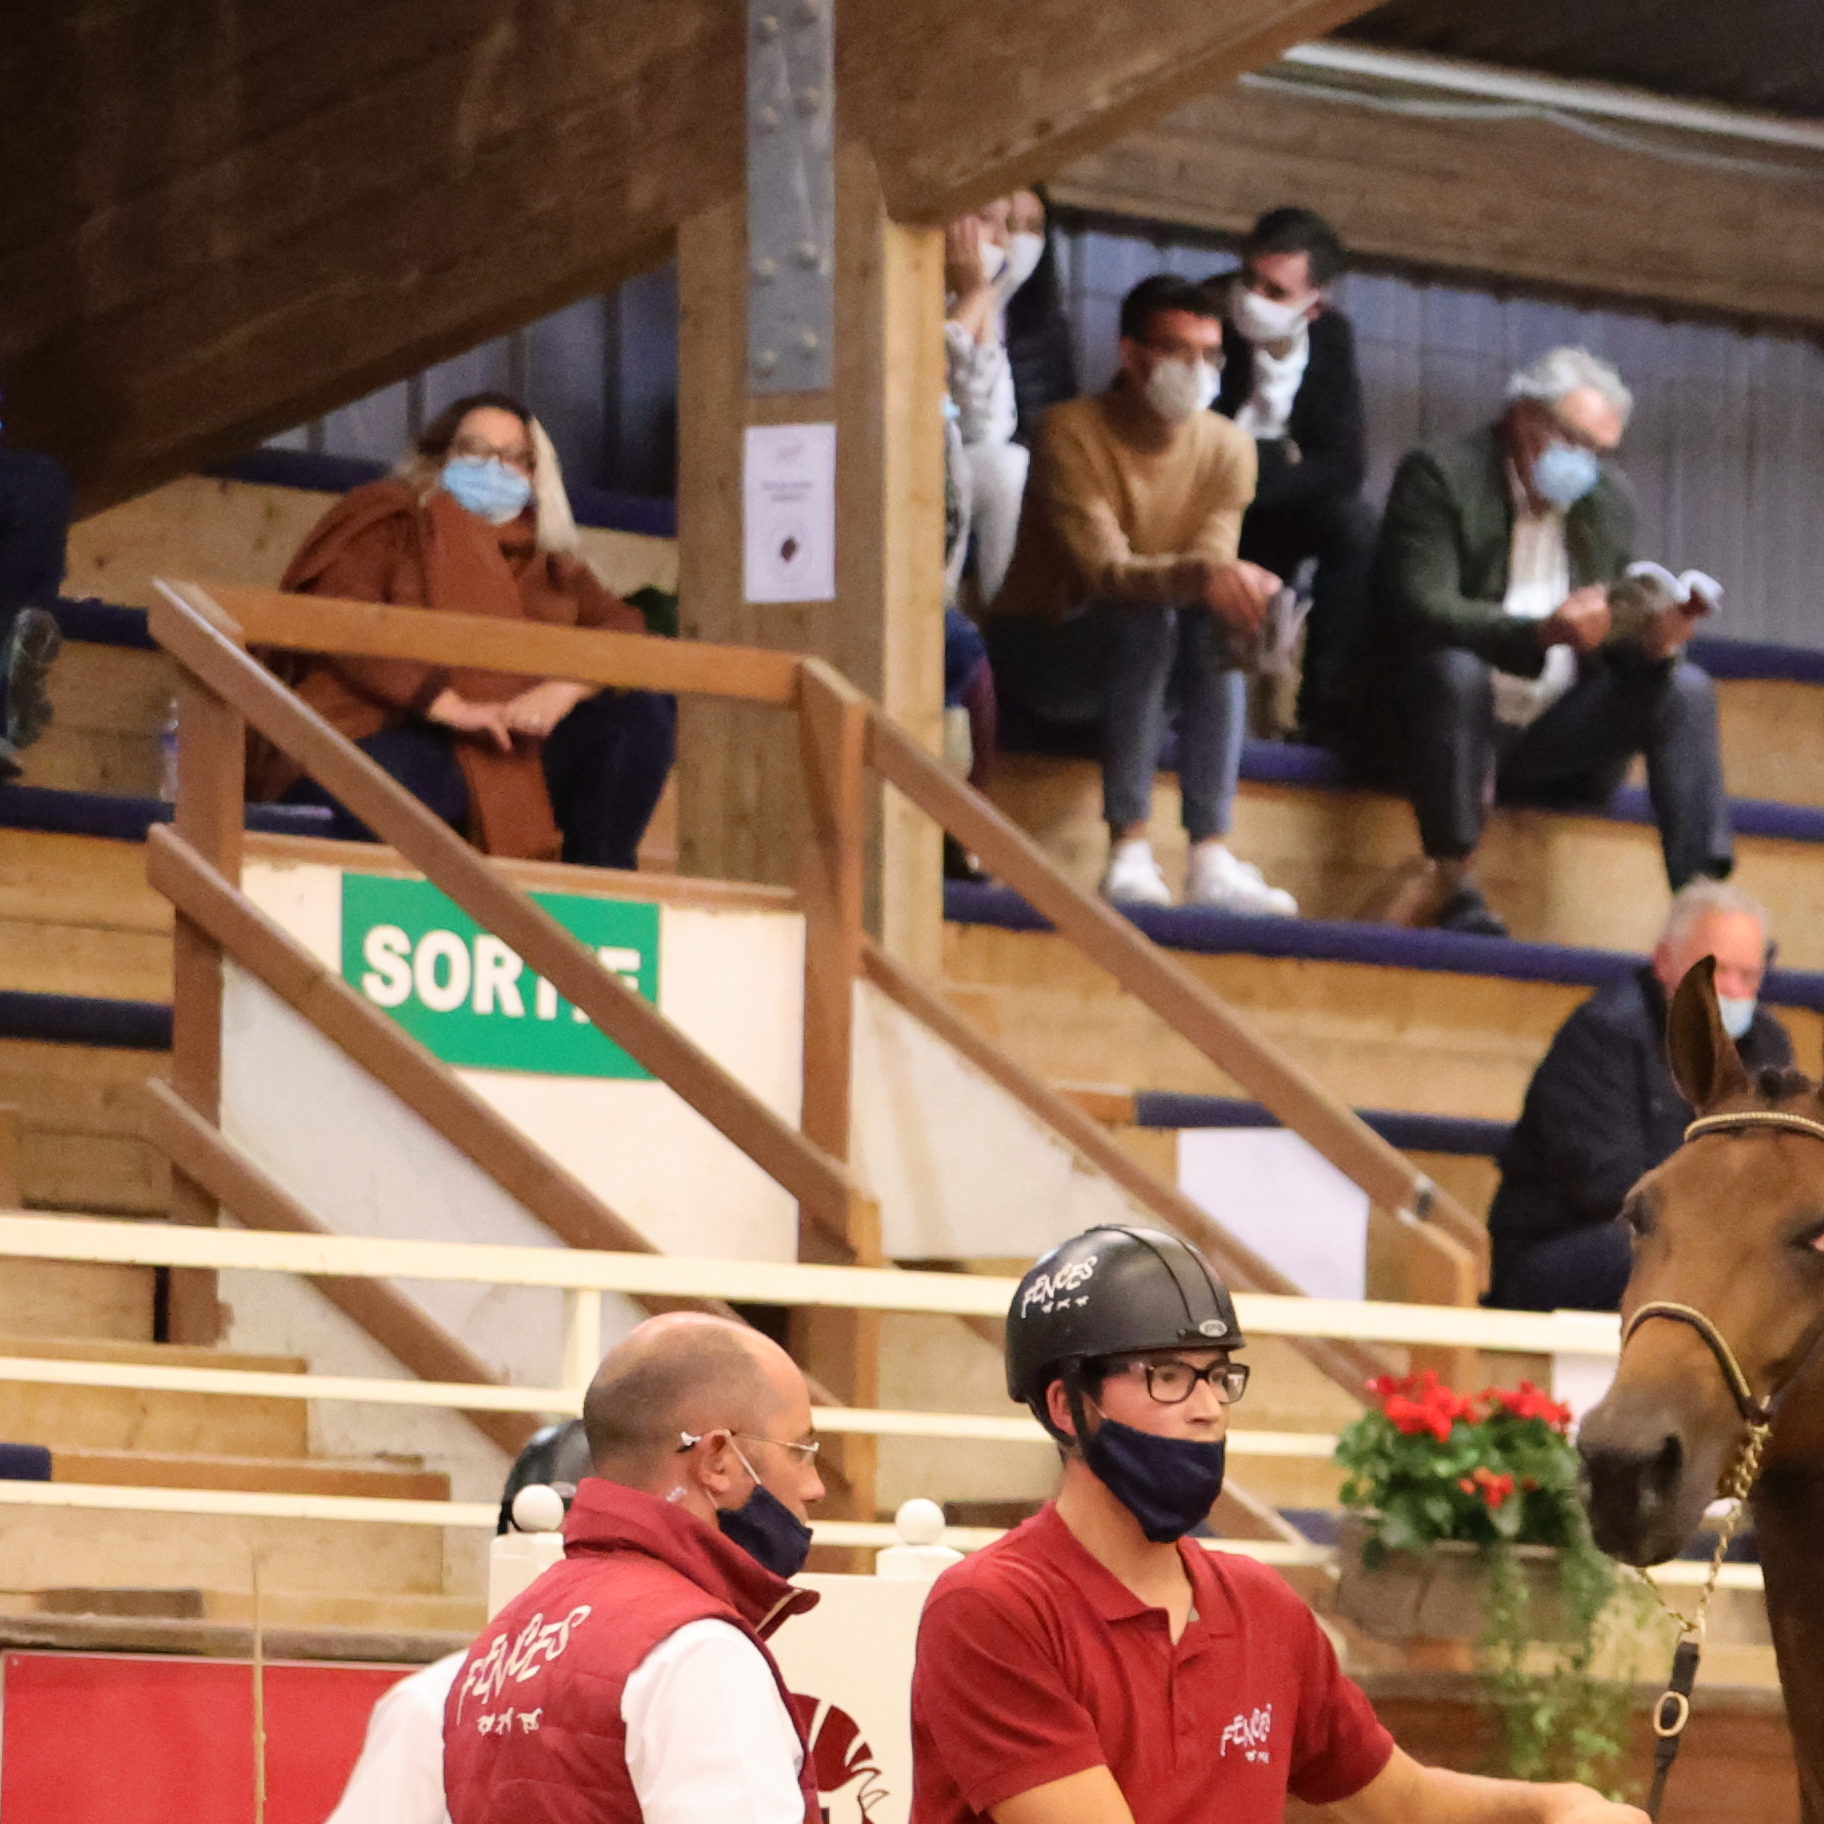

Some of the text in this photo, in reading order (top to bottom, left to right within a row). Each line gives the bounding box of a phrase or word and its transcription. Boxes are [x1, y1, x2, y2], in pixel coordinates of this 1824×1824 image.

[362, 923, 642, 1025] SOR
[1020, 1255, 1098, 1318] FENCES
[456, 1604, 593, 1726] FENCES
